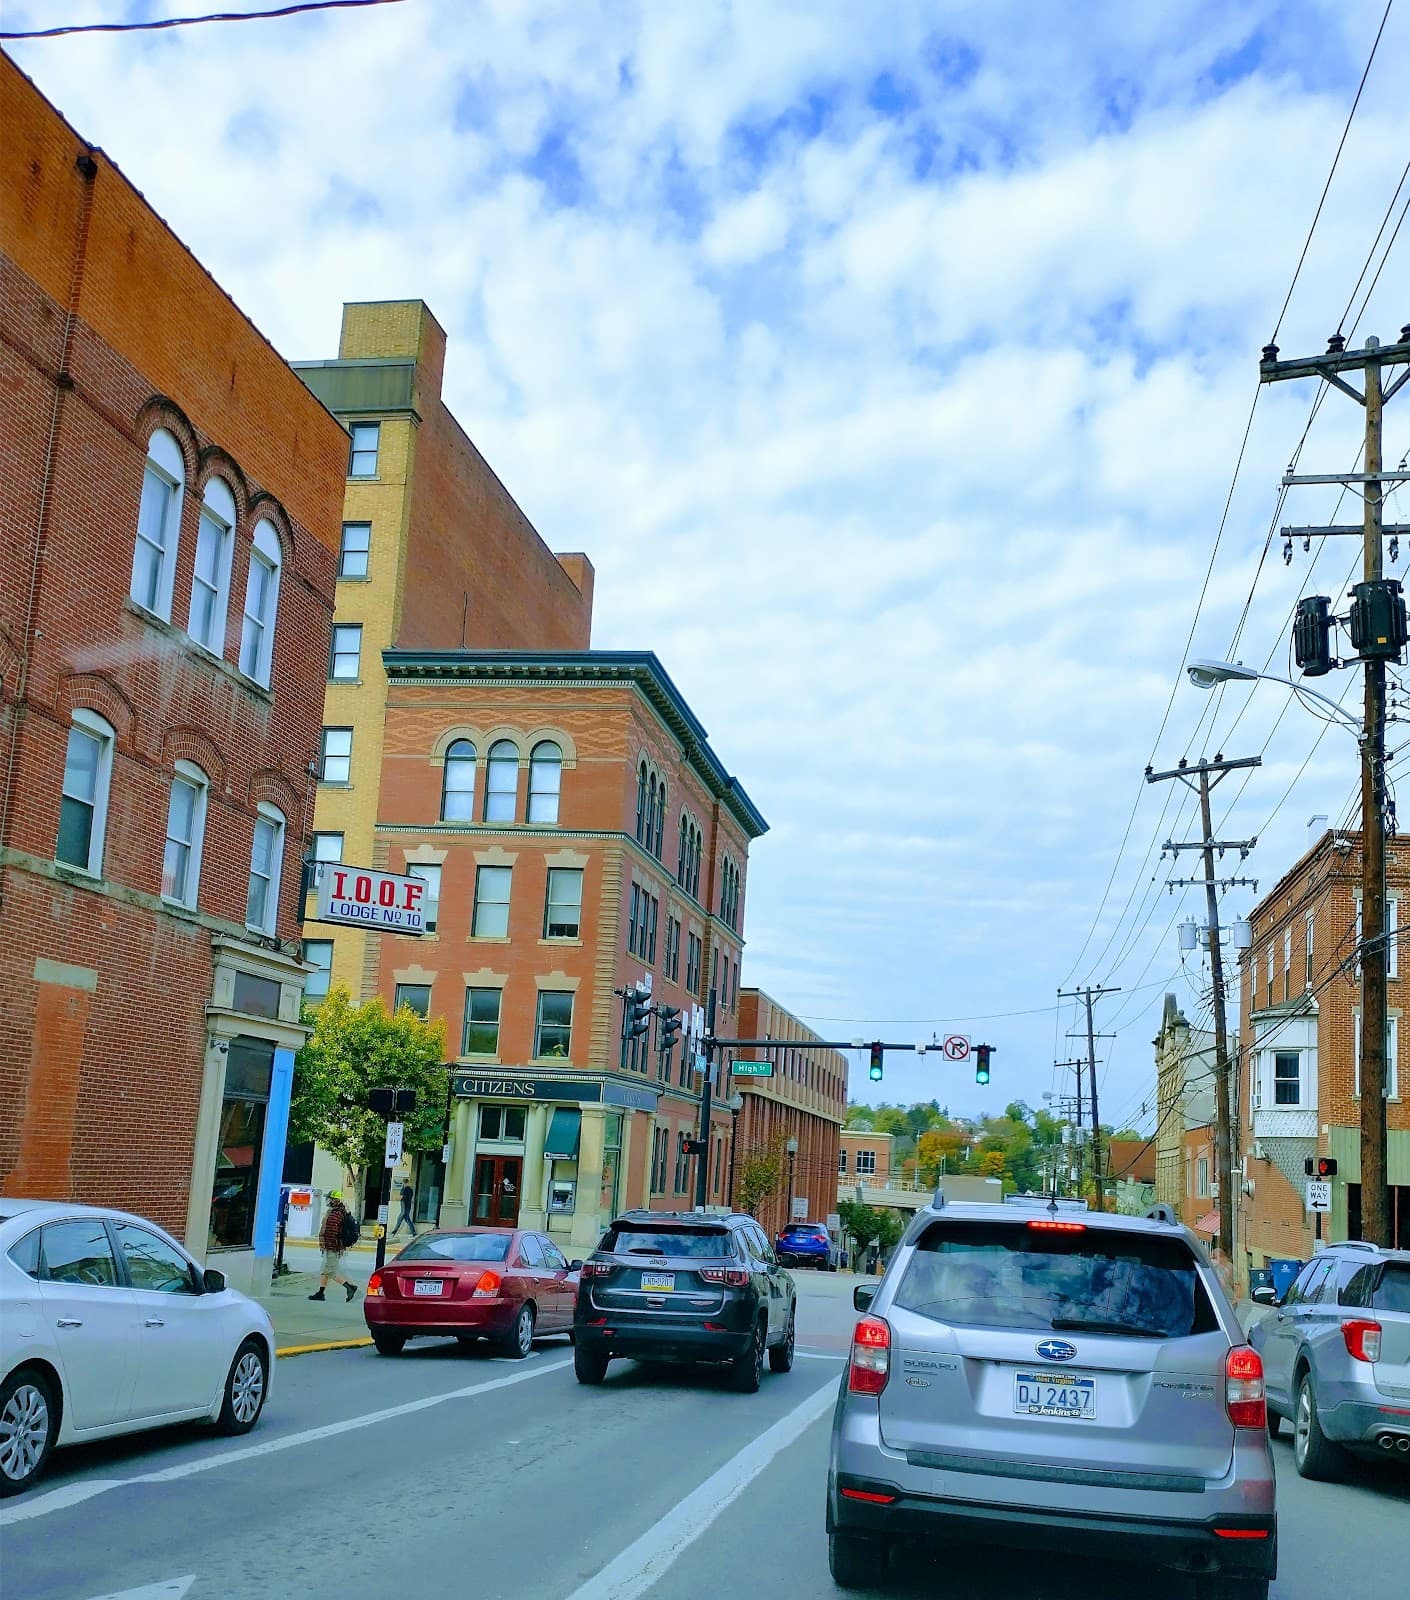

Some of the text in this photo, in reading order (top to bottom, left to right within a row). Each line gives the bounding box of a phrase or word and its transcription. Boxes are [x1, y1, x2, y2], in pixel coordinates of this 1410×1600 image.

[331, 872, 423, 912] I.O.O.F.
[330, 901, 379, 920] LODGE
[406, 913, 421, 927] 10
[738, 1065, 758, 1074] High
[462, 1079, 535, 1096] CITIZENS
[390, 1127, 400, 1136] ONE
[1310, 1184, 1328, 1192] ONE
[1310, 1192, 1328, 1200] WAY
[649, 1258, 668, 1266] Jeep
[903, 1359, 958, 1370] SUBARU
[1019, 1385, 1091, 1408] DJ 2437
[1039, 1405, 1071, 1417] Jenkins
